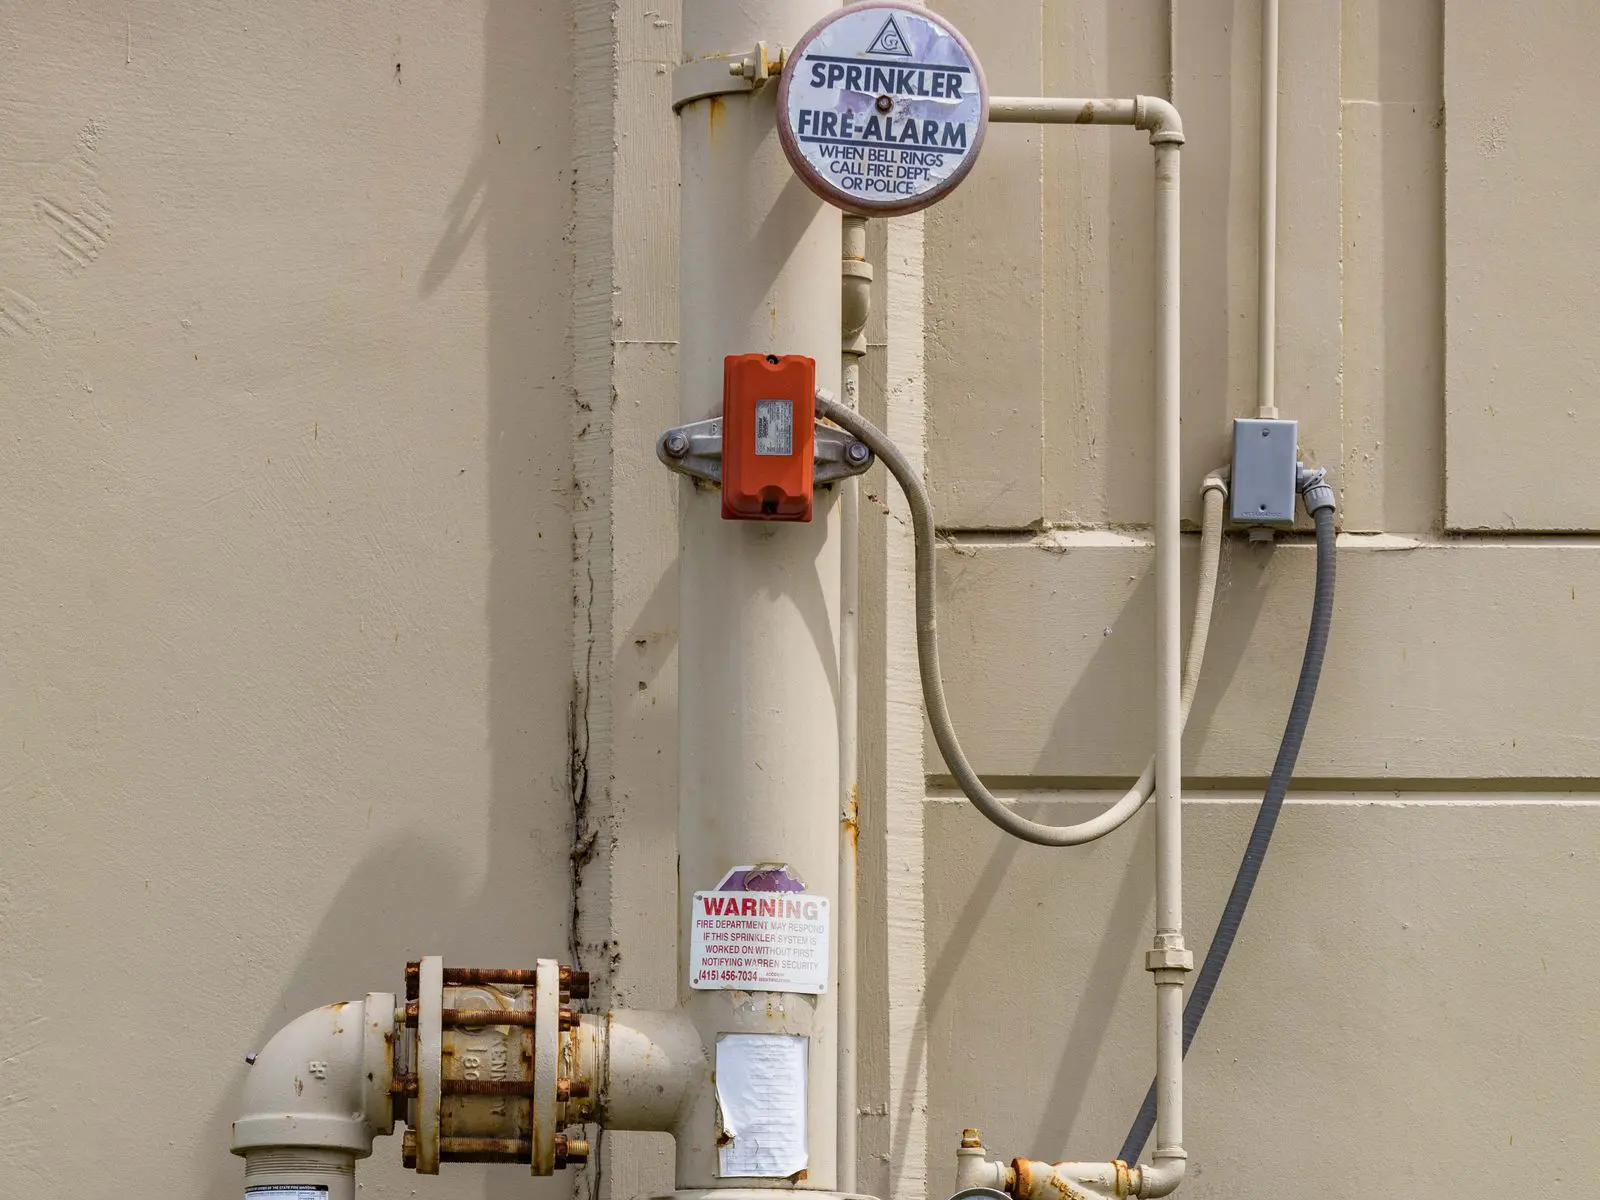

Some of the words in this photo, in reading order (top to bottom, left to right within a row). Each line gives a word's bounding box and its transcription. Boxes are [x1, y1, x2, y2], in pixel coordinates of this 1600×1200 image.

[810, 62, 963, 99] SPRINKLER
[798, 109, 967, 148] FIRE-ALARM
[819, 144, 864, 161] WHEN
[868, 149, 897, 164] BELL
[900, 151, 944, 168] RINGS
[830, 160, 864, 176] CALL
[867, 163, 894, 178] FIRE
[896, 166, 930, 181] DEPT.
[841, 176, 862, 190] OR
[865, 179, 914, 195] POLICE
[703, 897, 818, 920] WARNING
[697, 920, 713, 929] FIRE
[716, 920, 768, 930] DEPARTMENT
[771, 921, 787, 931] MAY
[788, 922, 825, 934] RESPOND
[703, 932, 711, 940] IF
[712, 932, 729, 941] THIS
[730, 933, 776, 942] SPRINKLER
[777, 934, 808, 945] SYSTEM
[809, 936, 817, 946] IS
[705, 945, 740, 954] WORKED
[741, 946, 754, 954] ON
[755, 946, 791, 956] WITHOUT
[793, 948, 815, 958] FIRST
[701, 957, 743, 967] NOTIFYING
[744, 958, 780, 968] WARREN
[781, 959, 819, 970] SECURITY
[698, 970, 719, 981] (415)
[720, 970, 757, 982] 456-7034
